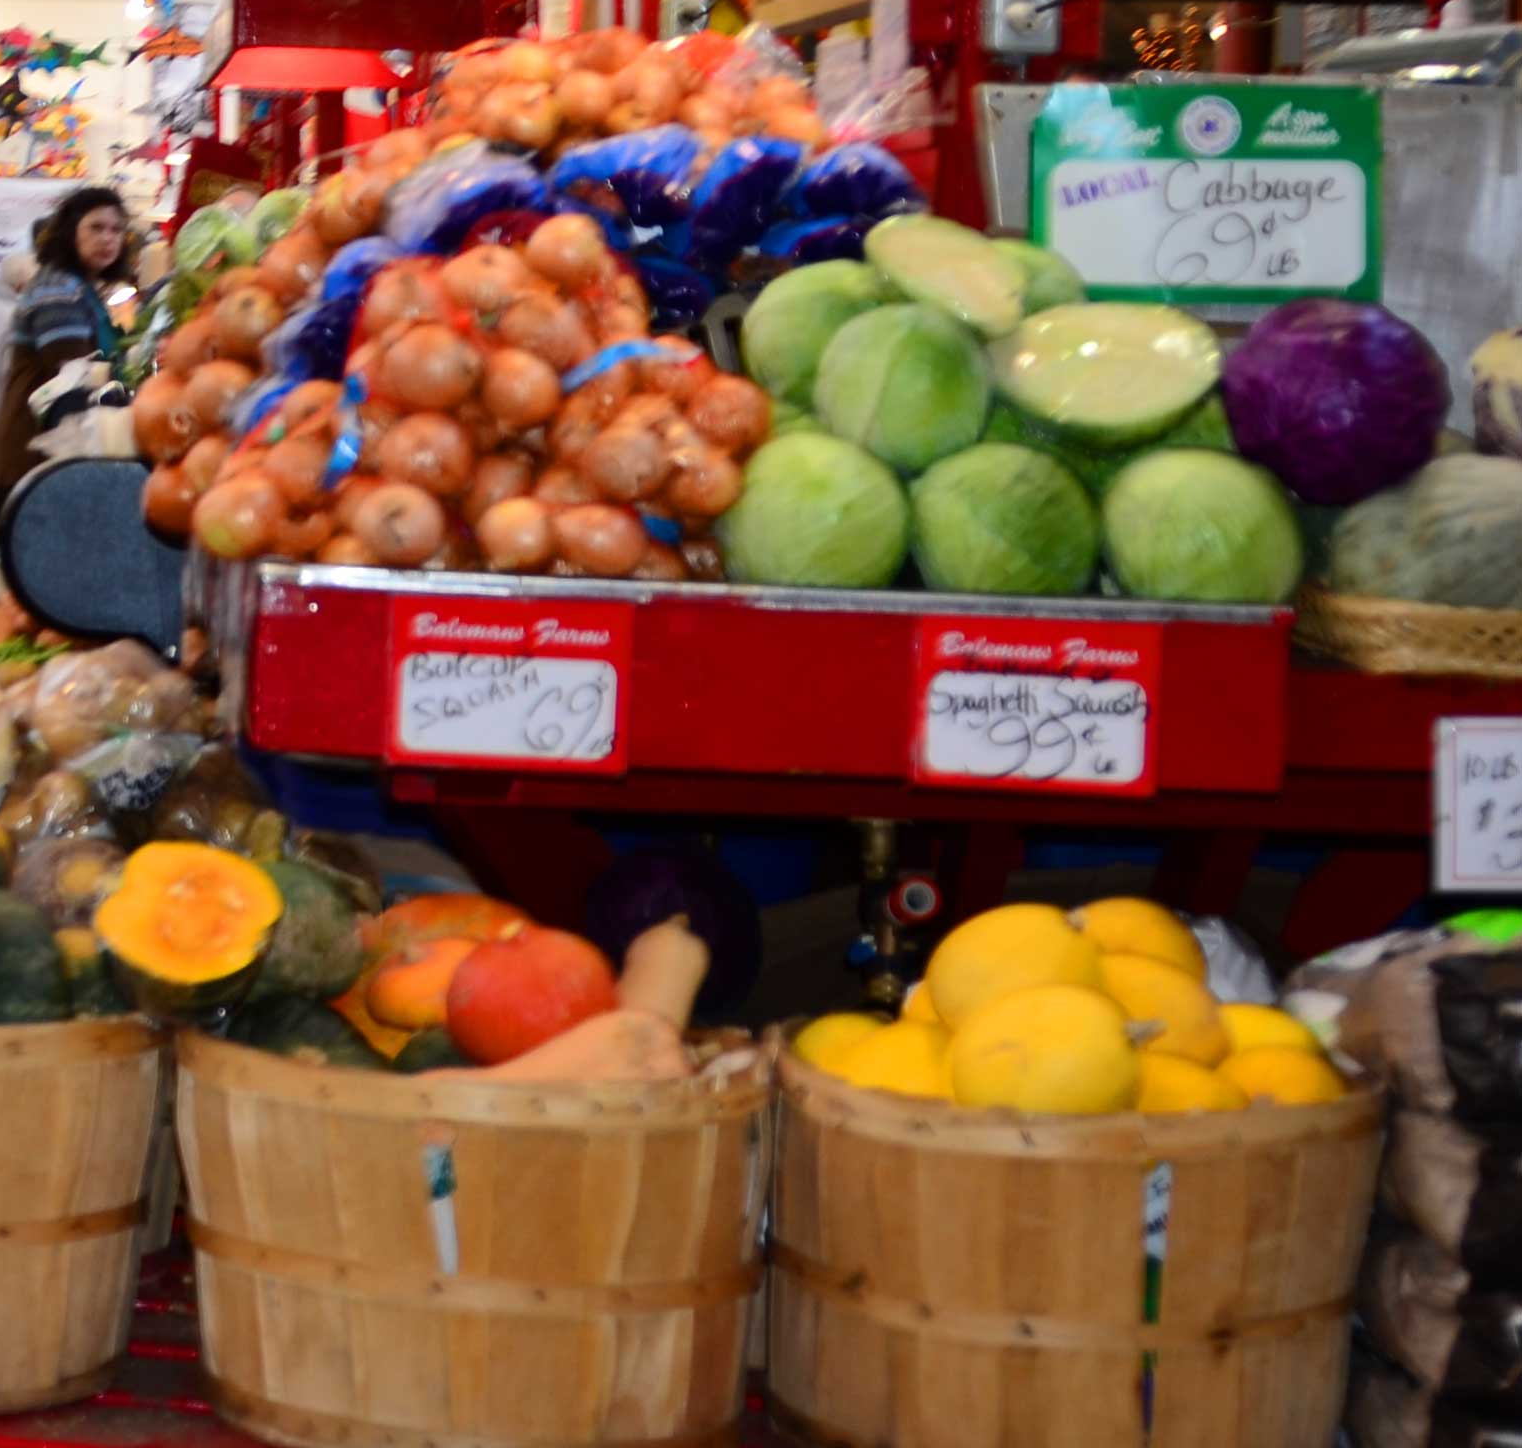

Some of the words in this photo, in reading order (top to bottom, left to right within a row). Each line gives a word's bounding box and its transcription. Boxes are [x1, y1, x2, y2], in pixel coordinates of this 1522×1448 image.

[1164, 160, 1346, 222] Cabbage
[411, 612, 525, 642] Balemans
[532, 618, 611, 648] Farms
[936, 630, 1052, 661] Balemans
[1059, 637, 1140, 668] Farms
